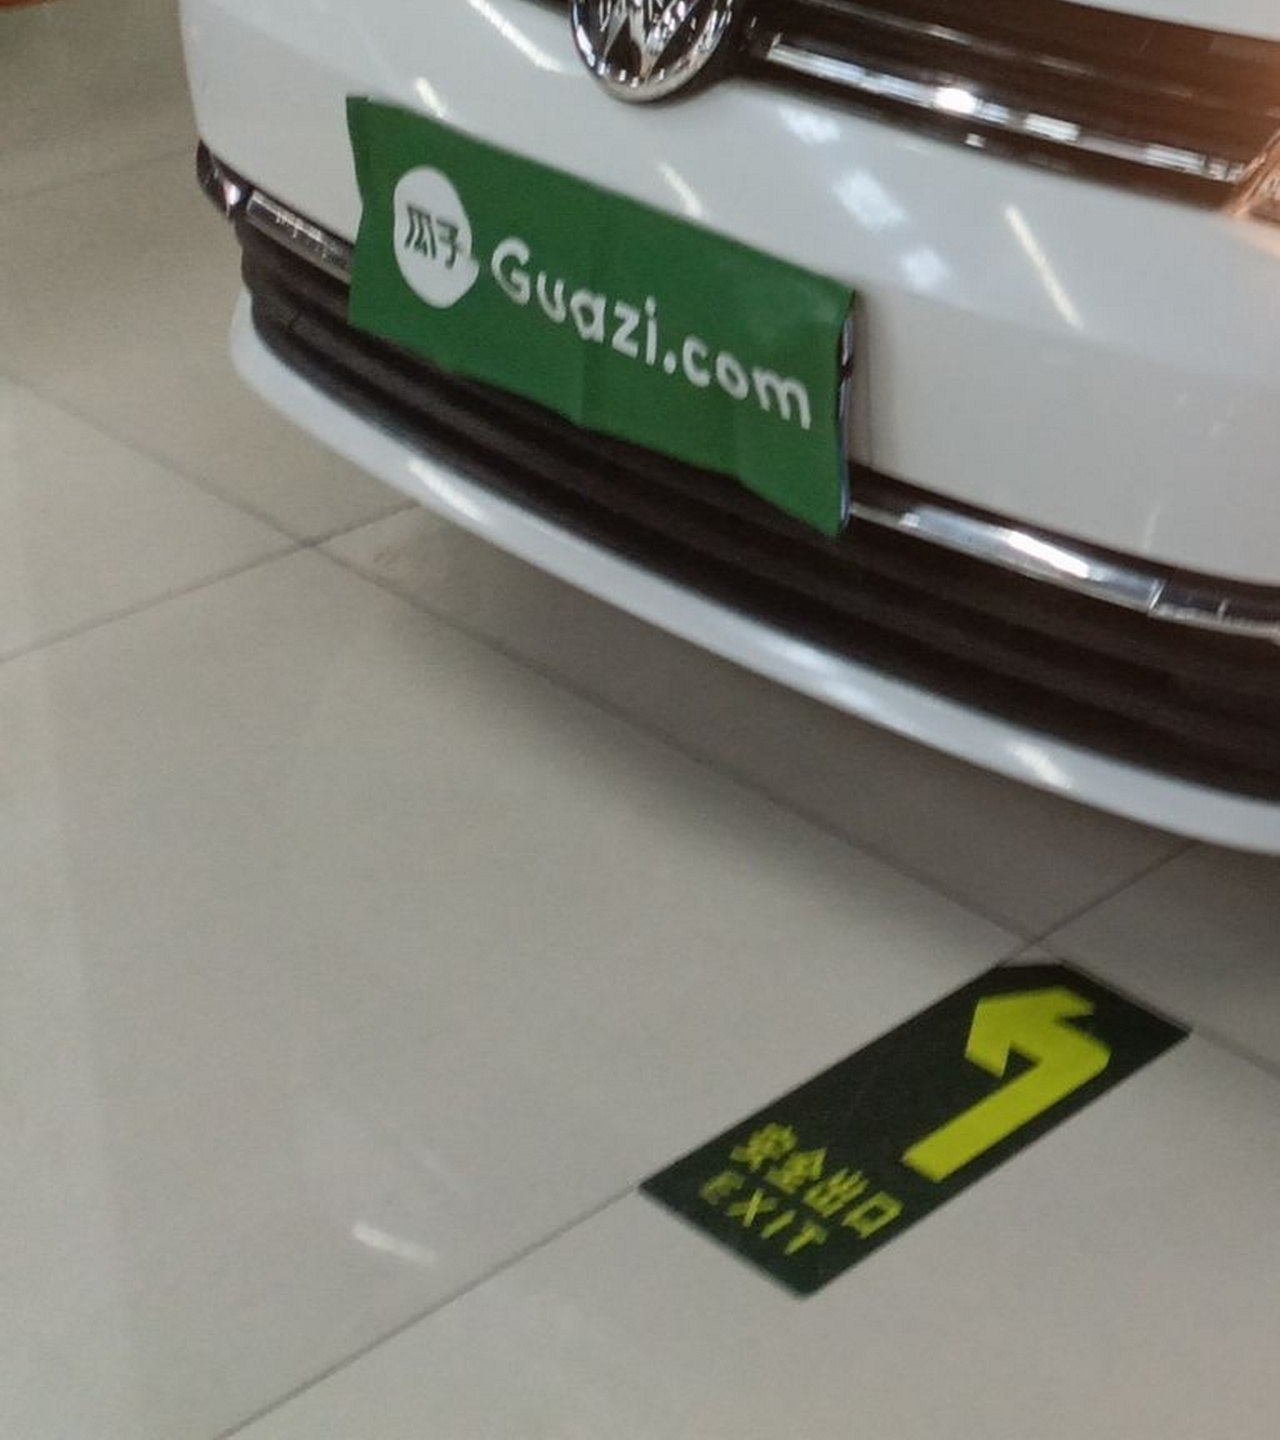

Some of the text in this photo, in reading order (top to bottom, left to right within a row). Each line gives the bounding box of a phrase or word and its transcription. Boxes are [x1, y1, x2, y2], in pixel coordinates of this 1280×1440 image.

[405, 204, 467, 270] 瓜子
[490, 237, 812, 431] Guazi.com
[700, 1169, 829, 1256] EXIT
[730, 1122, 903, 1239] 安全出口
